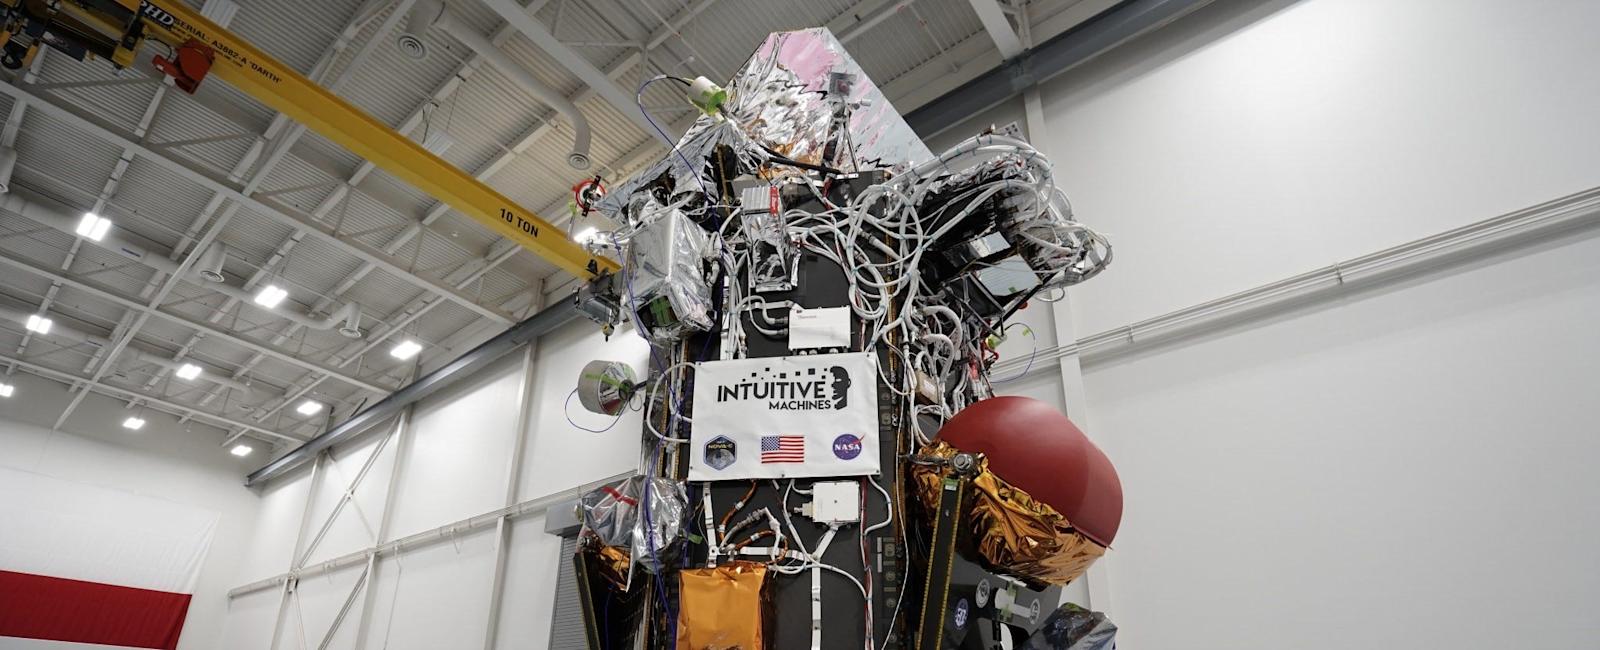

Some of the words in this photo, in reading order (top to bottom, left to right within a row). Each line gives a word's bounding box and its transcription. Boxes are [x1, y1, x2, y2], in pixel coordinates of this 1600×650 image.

[500, 208, 513, 223] 10
[517, 216, 539, 238] TON
[717, 381, 826, 402] INTUITIVE
[769, 400, 831, 410] MACHINES
